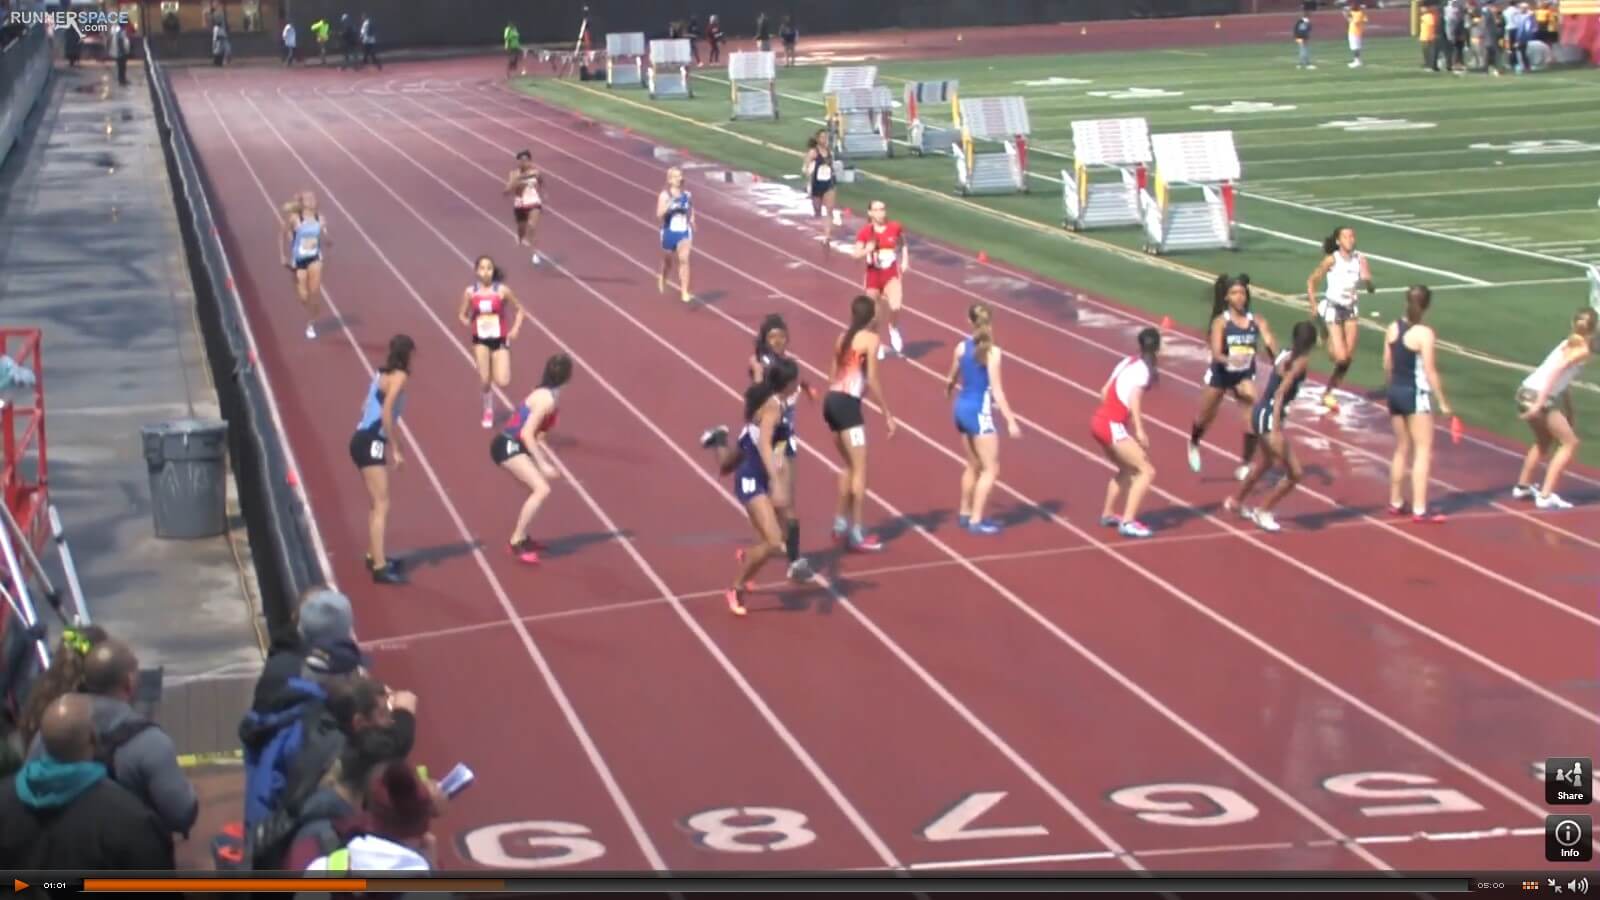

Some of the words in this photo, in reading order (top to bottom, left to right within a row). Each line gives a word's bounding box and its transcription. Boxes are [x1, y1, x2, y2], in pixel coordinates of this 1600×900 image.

[923, 791, 1050, 842] 7
[1322, 771, 1486, 817] 5
[688, 806, 817, 852] 8
